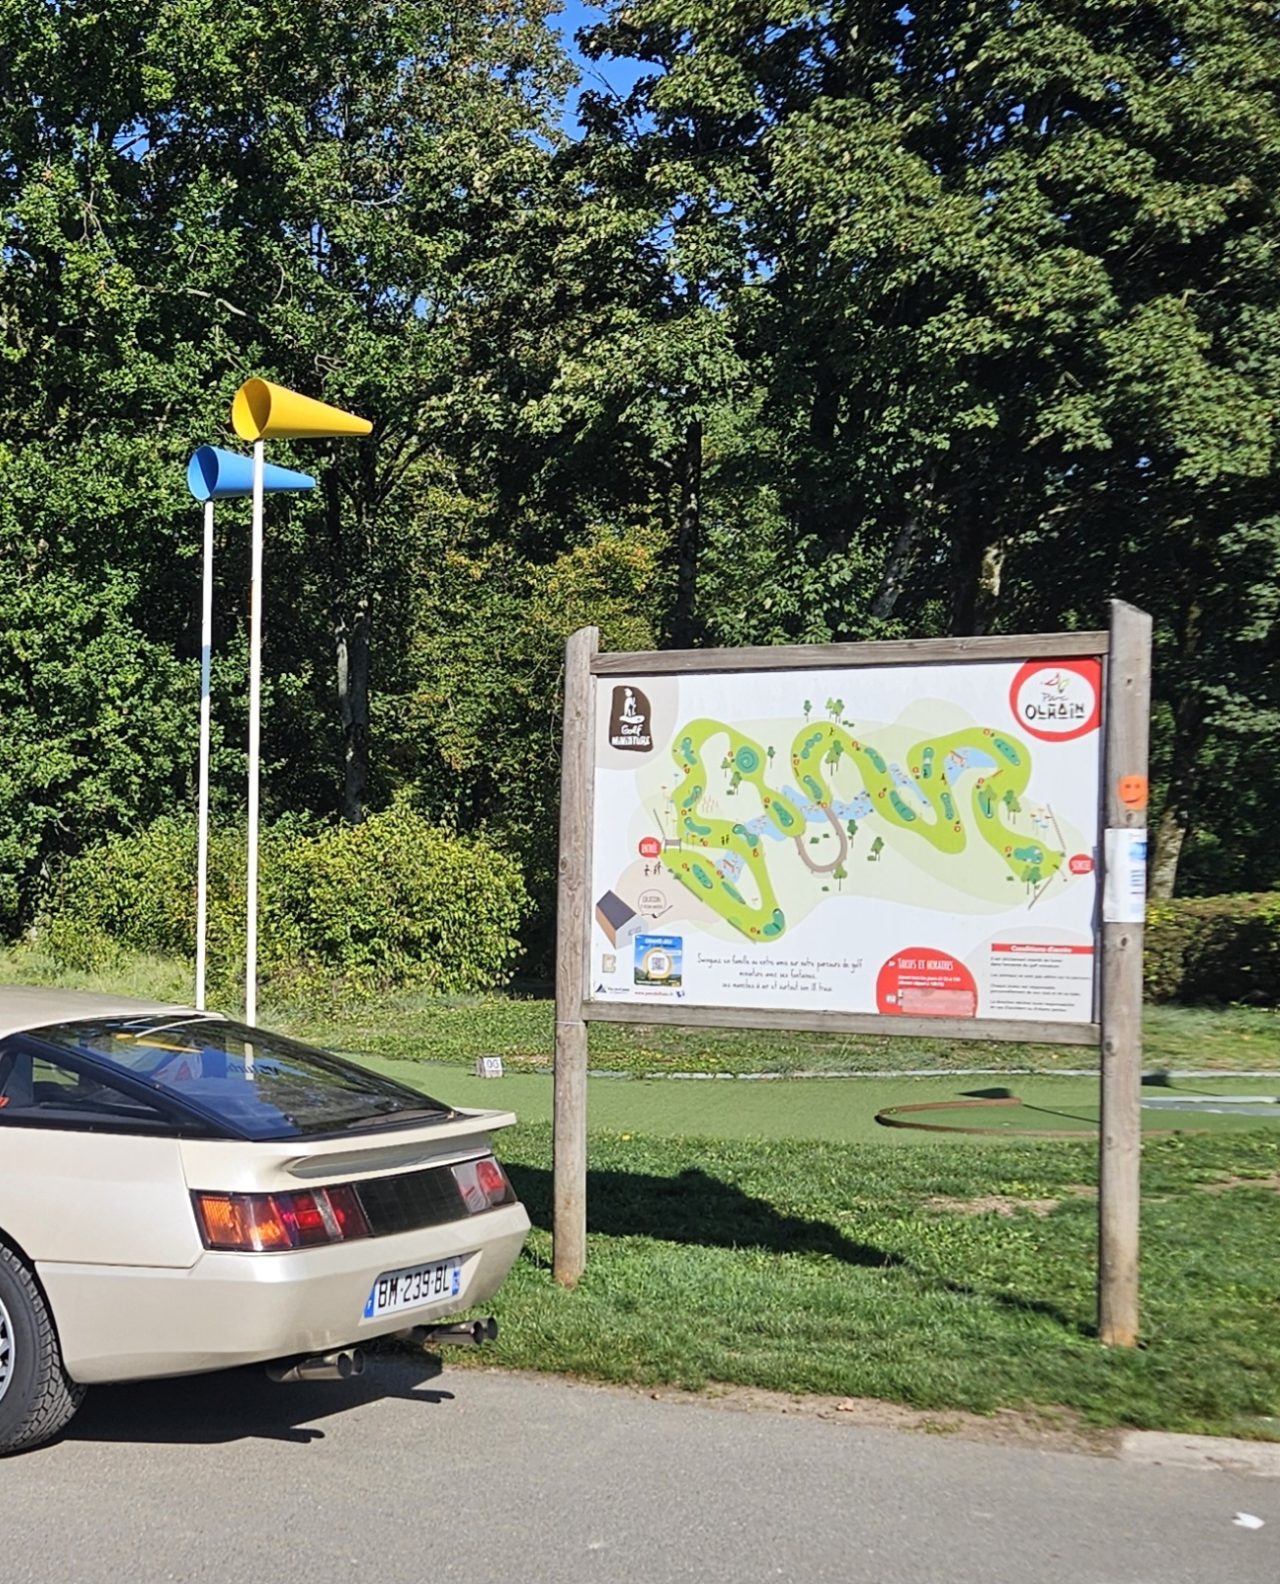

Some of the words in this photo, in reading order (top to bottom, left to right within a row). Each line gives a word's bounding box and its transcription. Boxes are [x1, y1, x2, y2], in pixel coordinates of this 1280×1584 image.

[1025, 703, 1085, 720] OLHAIN
[621, 724, 644, 737] Golf
[378, 1264, 450, 1309] BM-239-BL
